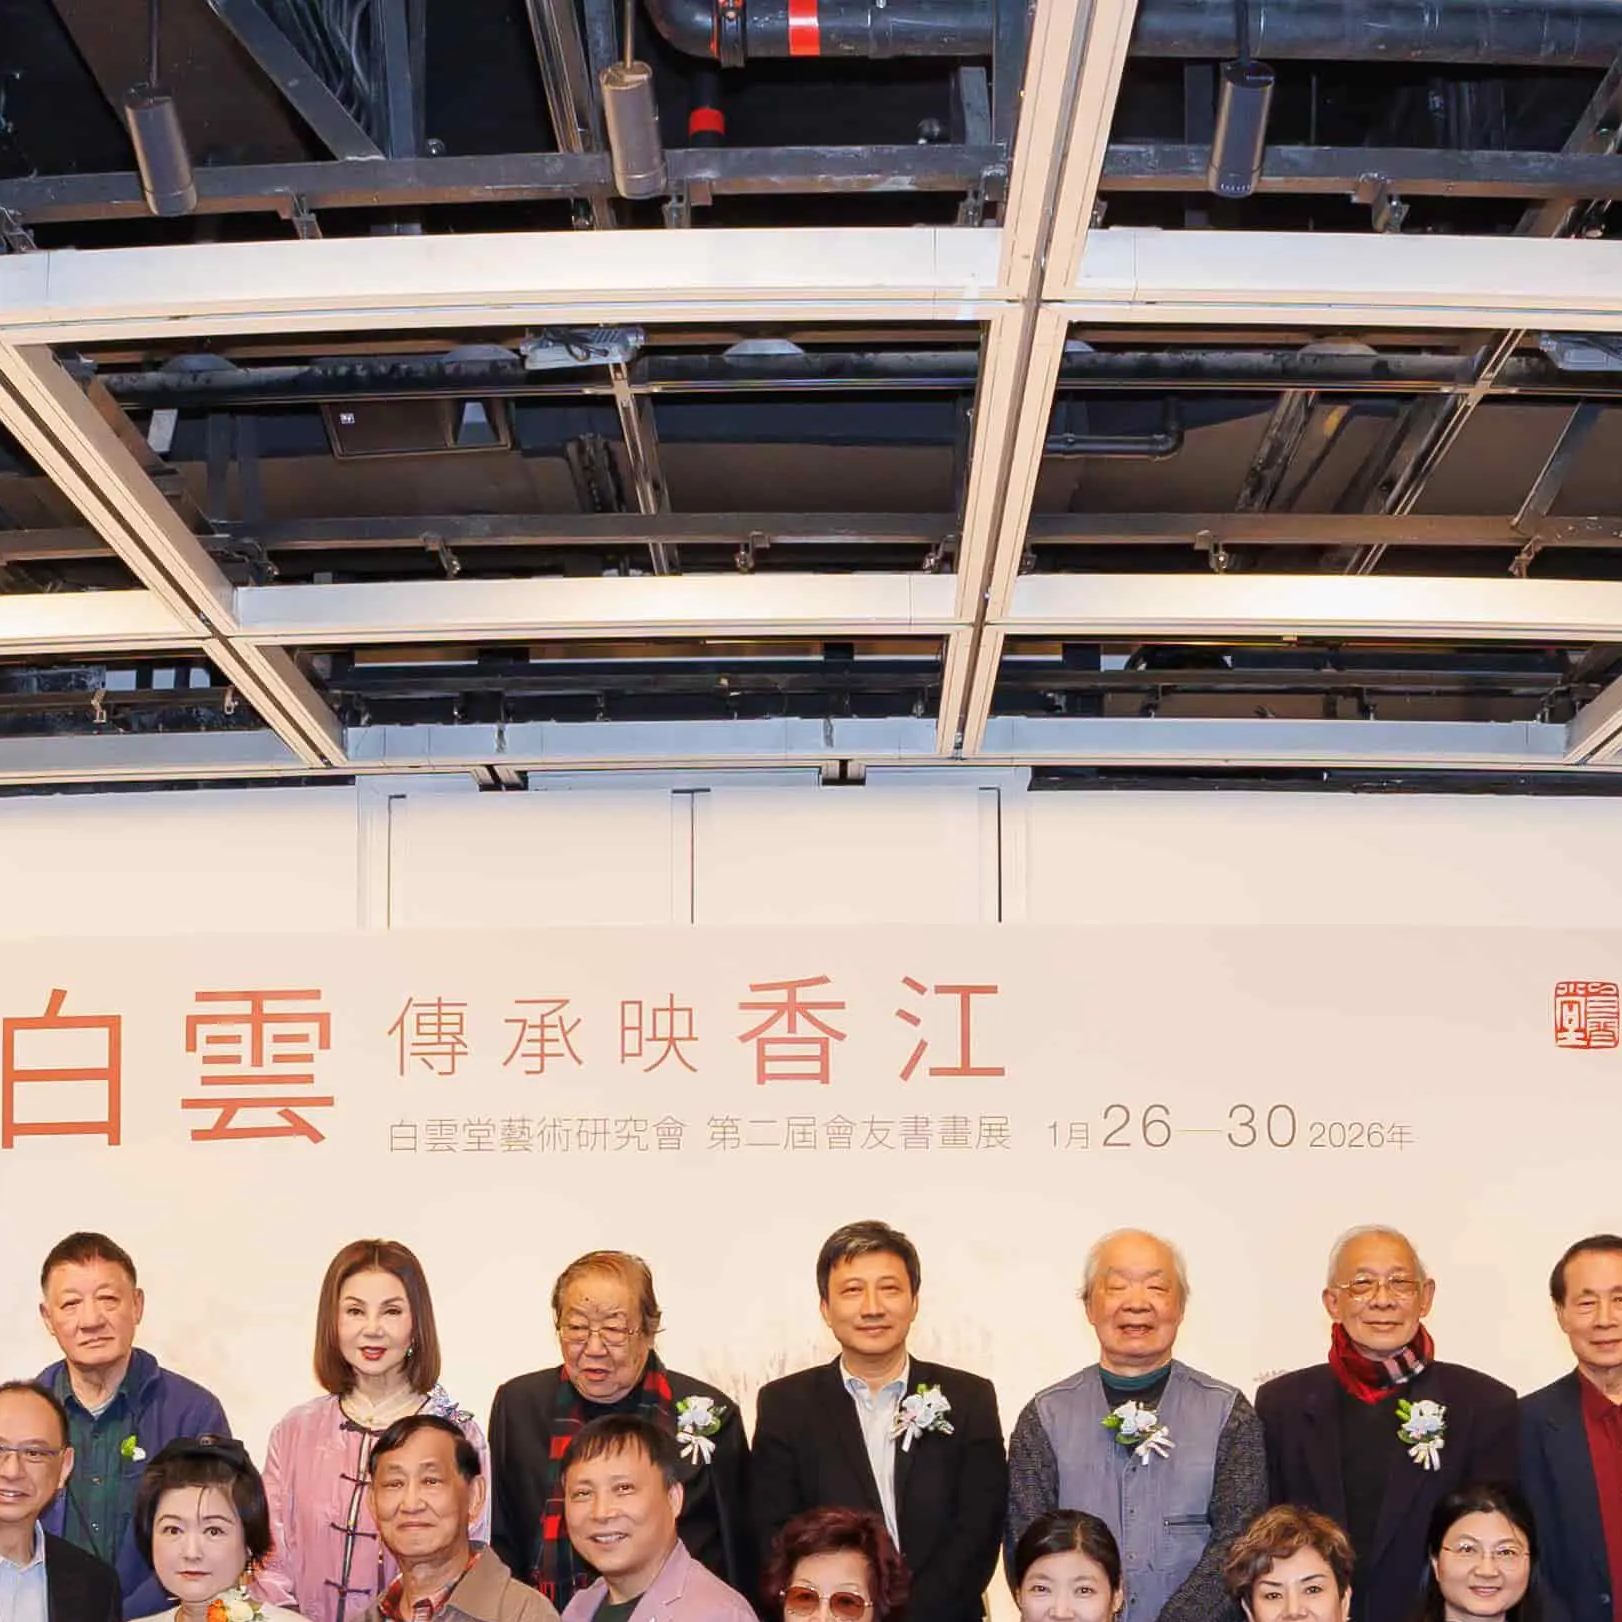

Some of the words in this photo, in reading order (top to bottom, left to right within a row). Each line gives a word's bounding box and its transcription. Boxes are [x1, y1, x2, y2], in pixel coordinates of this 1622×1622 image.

[1, 976, 1006, 1149] 白雲傳承映香江
[388, 1115, 687, 1153] 白雲堂藝術研究會
[706, 1114, 1012, 1152] 第二屆會友書畫展
